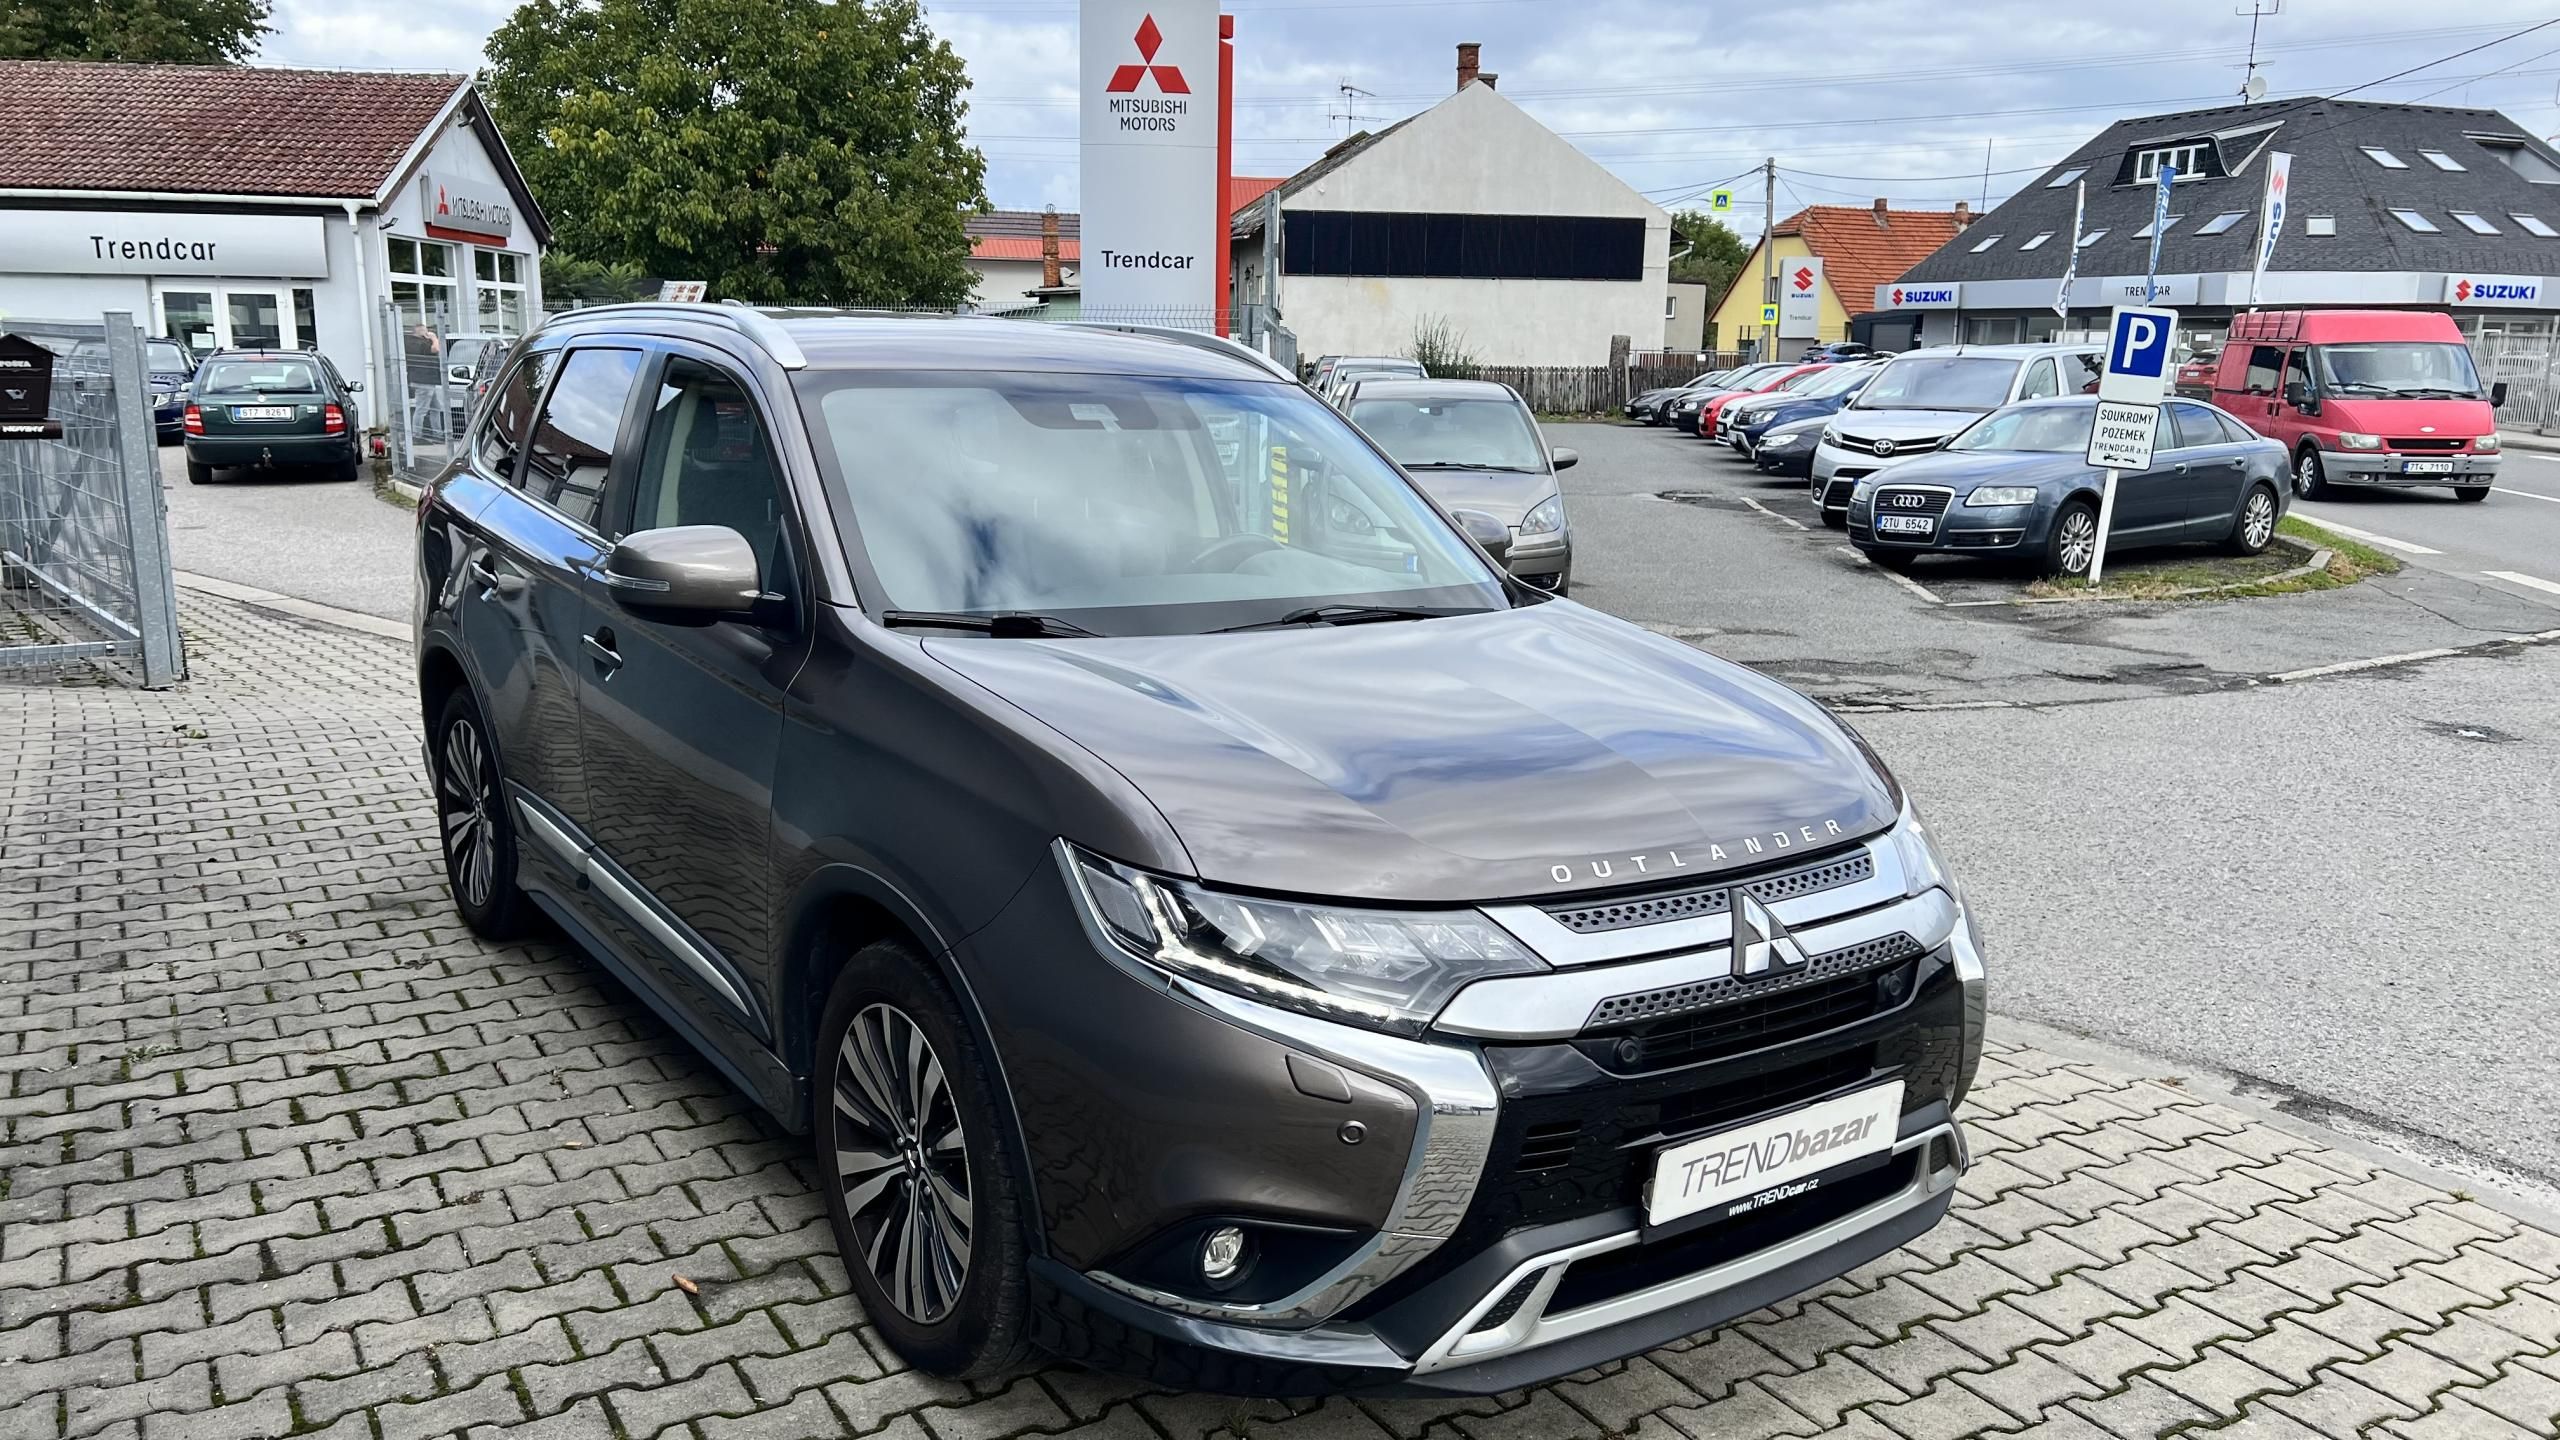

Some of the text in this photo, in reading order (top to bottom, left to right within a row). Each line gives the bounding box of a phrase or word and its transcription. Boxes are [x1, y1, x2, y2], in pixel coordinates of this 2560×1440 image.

[1110, 99, 1187, 114] MITSUBISHI
[1120, 116, 1176, 131] MOTORS
[90, 236, 216, 261] Trendcar
[1101, 250, 1194, 269] Trendcar
[1905, 290, 1953, 303] SUZUKI
[2124, 286, 2171, 297] TRENCAR
[2473, 284, 2537, 300] SUZUKI
[2122, 317, 2157, 369] P
[2101, 427, 2146, 441] POZEMEK
[2094, 442, 2135, 453] TRENDCAR
[1883, 517, 1929, 530] 2TU 6542
[1551, 819, 1842, 883] OUTLANDER
[1681, 1112, 1879, 1198] TRENDbazar
[1728, 1177, 1820, 1217] www.TRENDcar.cz
